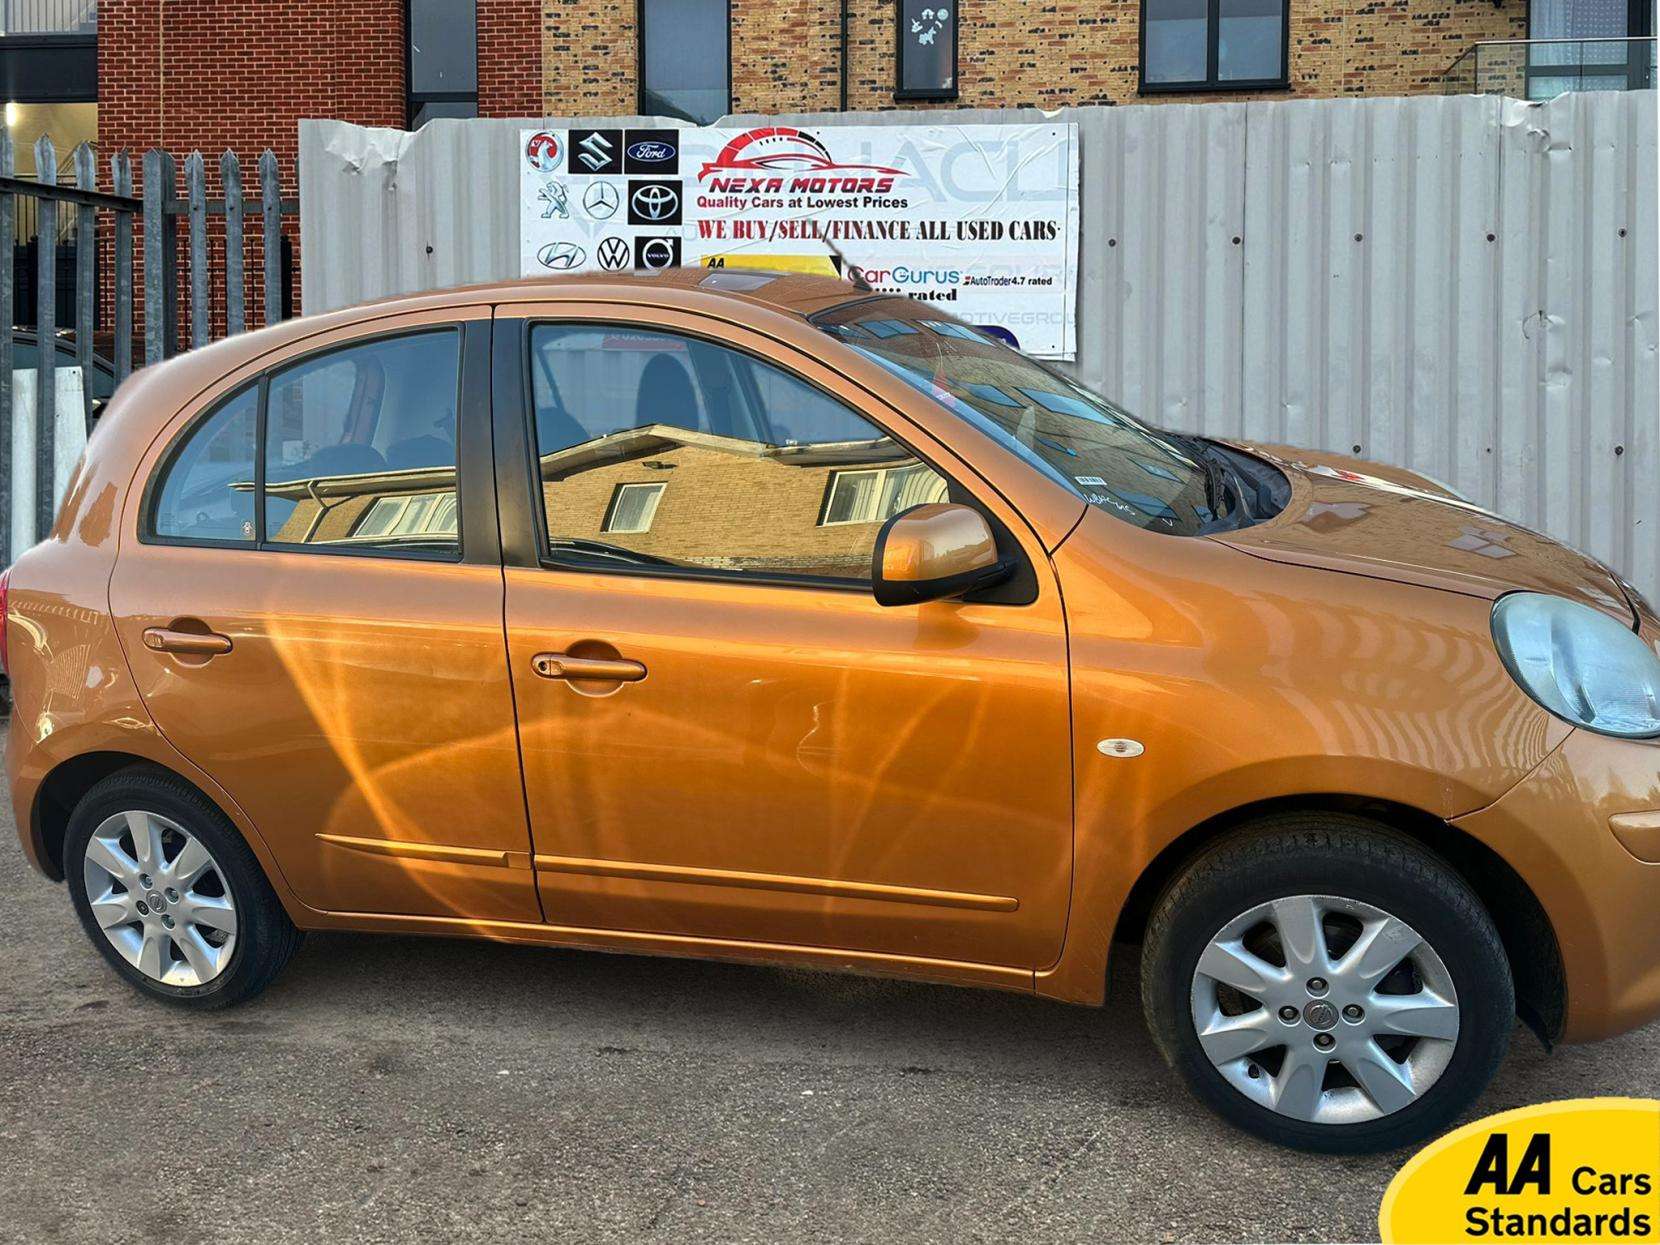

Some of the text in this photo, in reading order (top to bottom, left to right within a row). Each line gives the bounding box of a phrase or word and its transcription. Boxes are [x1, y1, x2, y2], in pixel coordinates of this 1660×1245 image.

[636, 144, 666, 159] Ford
[708, 177, 895, 194] NEXA MOTORS
[697, 195, 908, 211] Quality Cars at Lowest Prices
[697, 220, 727, 240] WE
[915, 220, 951, 240] ALL
[956, 220, 1004, 240] USED
[1008, 220, 1058, 240] CARS
[707, 257, 725, 269] AA
[1028, 276, 1053, 286] rated
[908, 288, 958, 301] rated
